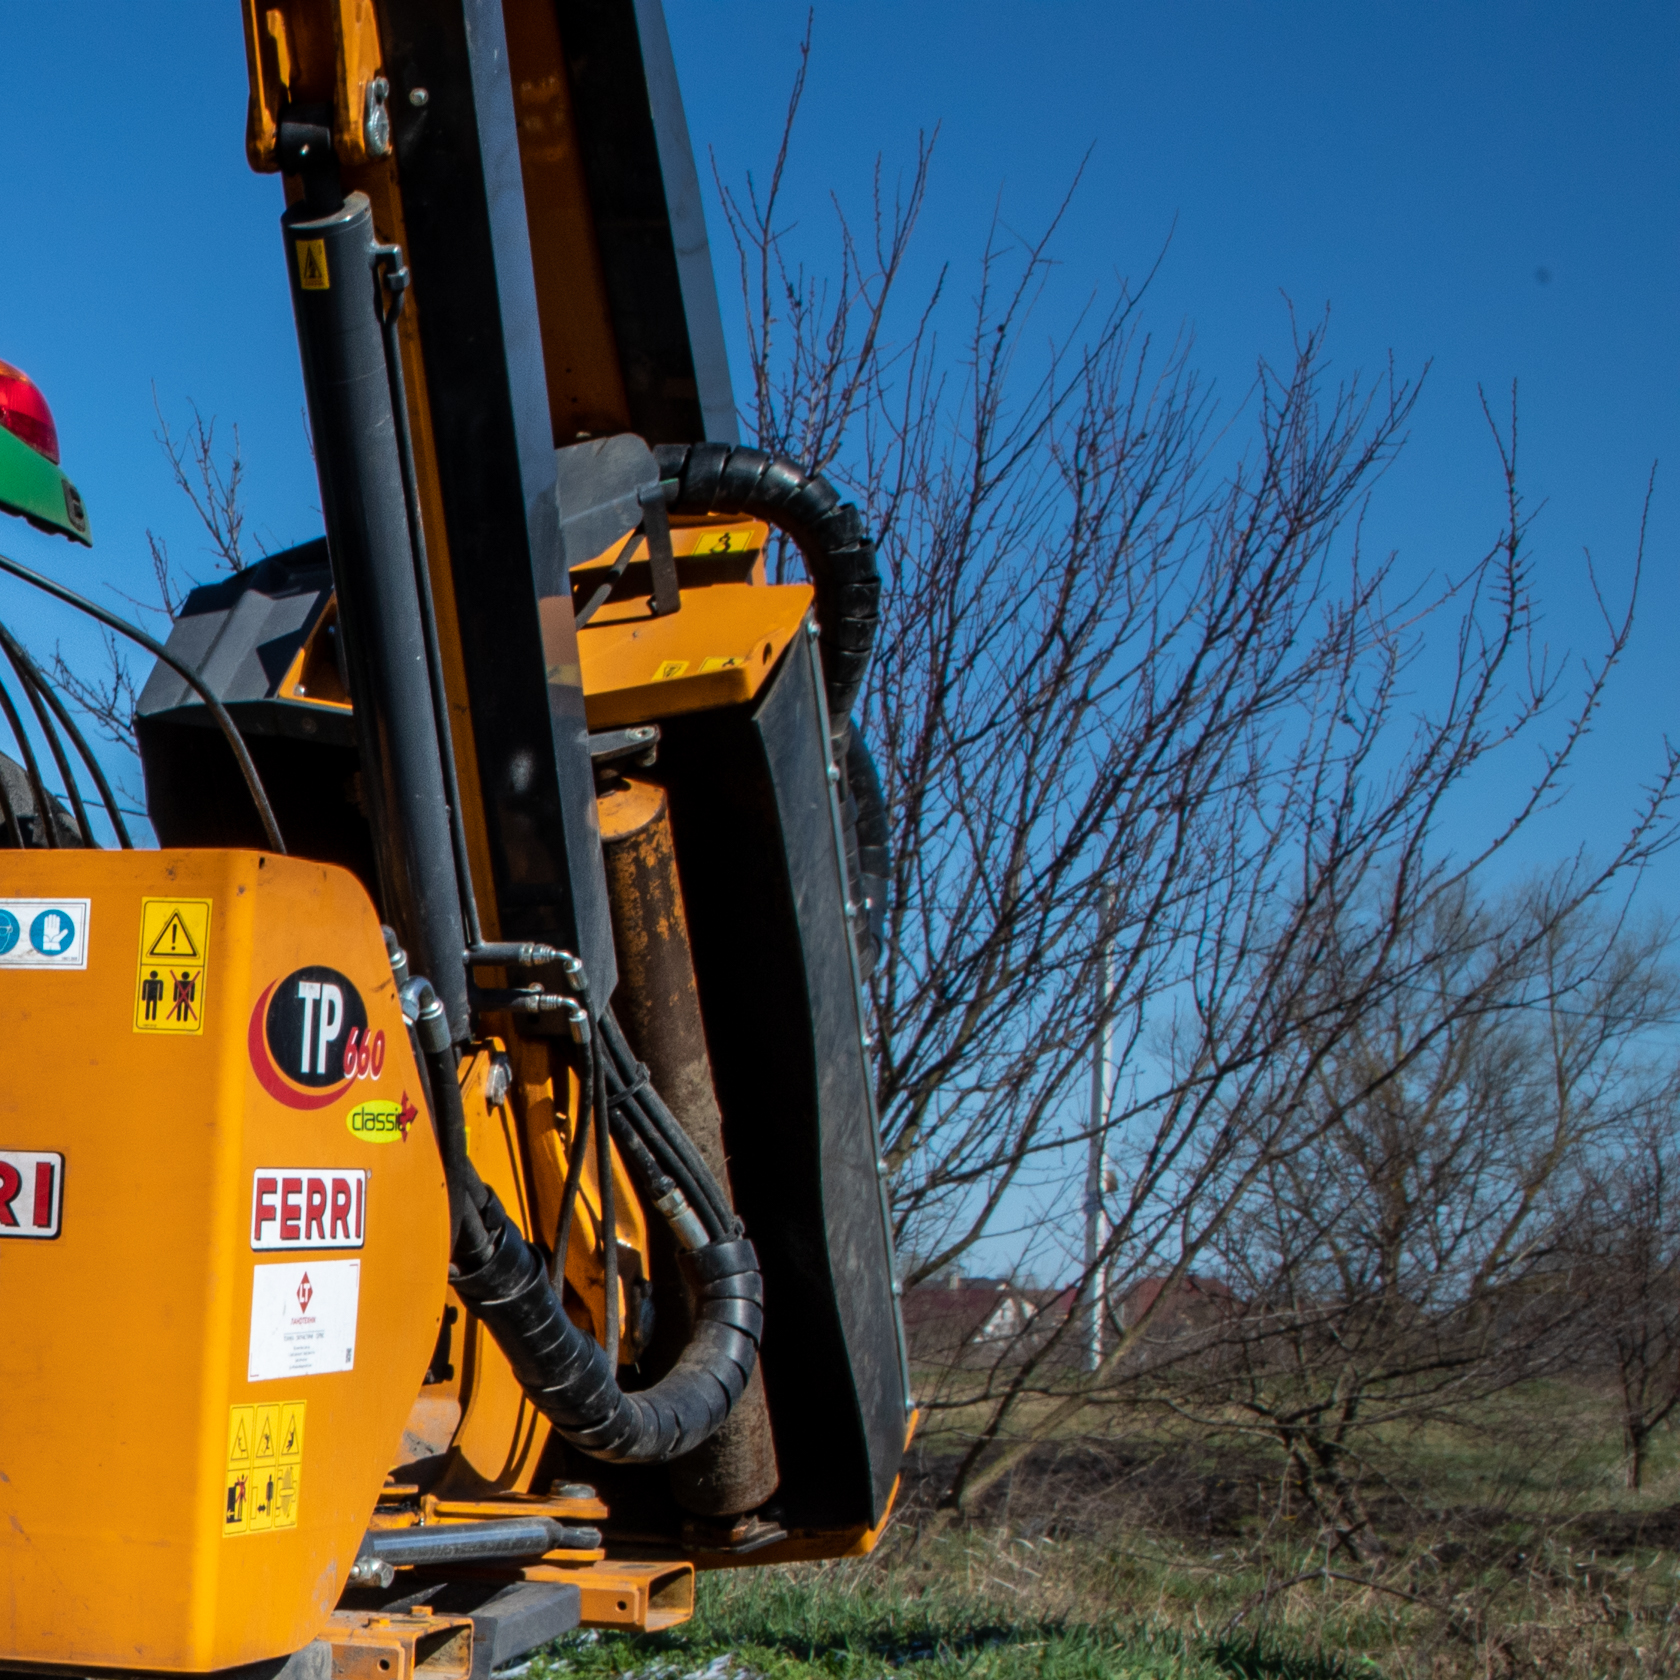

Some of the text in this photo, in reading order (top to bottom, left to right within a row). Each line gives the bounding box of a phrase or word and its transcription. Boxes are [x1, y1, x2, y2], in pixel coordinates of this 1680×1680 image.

[298, 980, 344, 1075] TP
[342, 1026, 386, 1081] 660
[253, 1176, 365, 1242] FERRI
